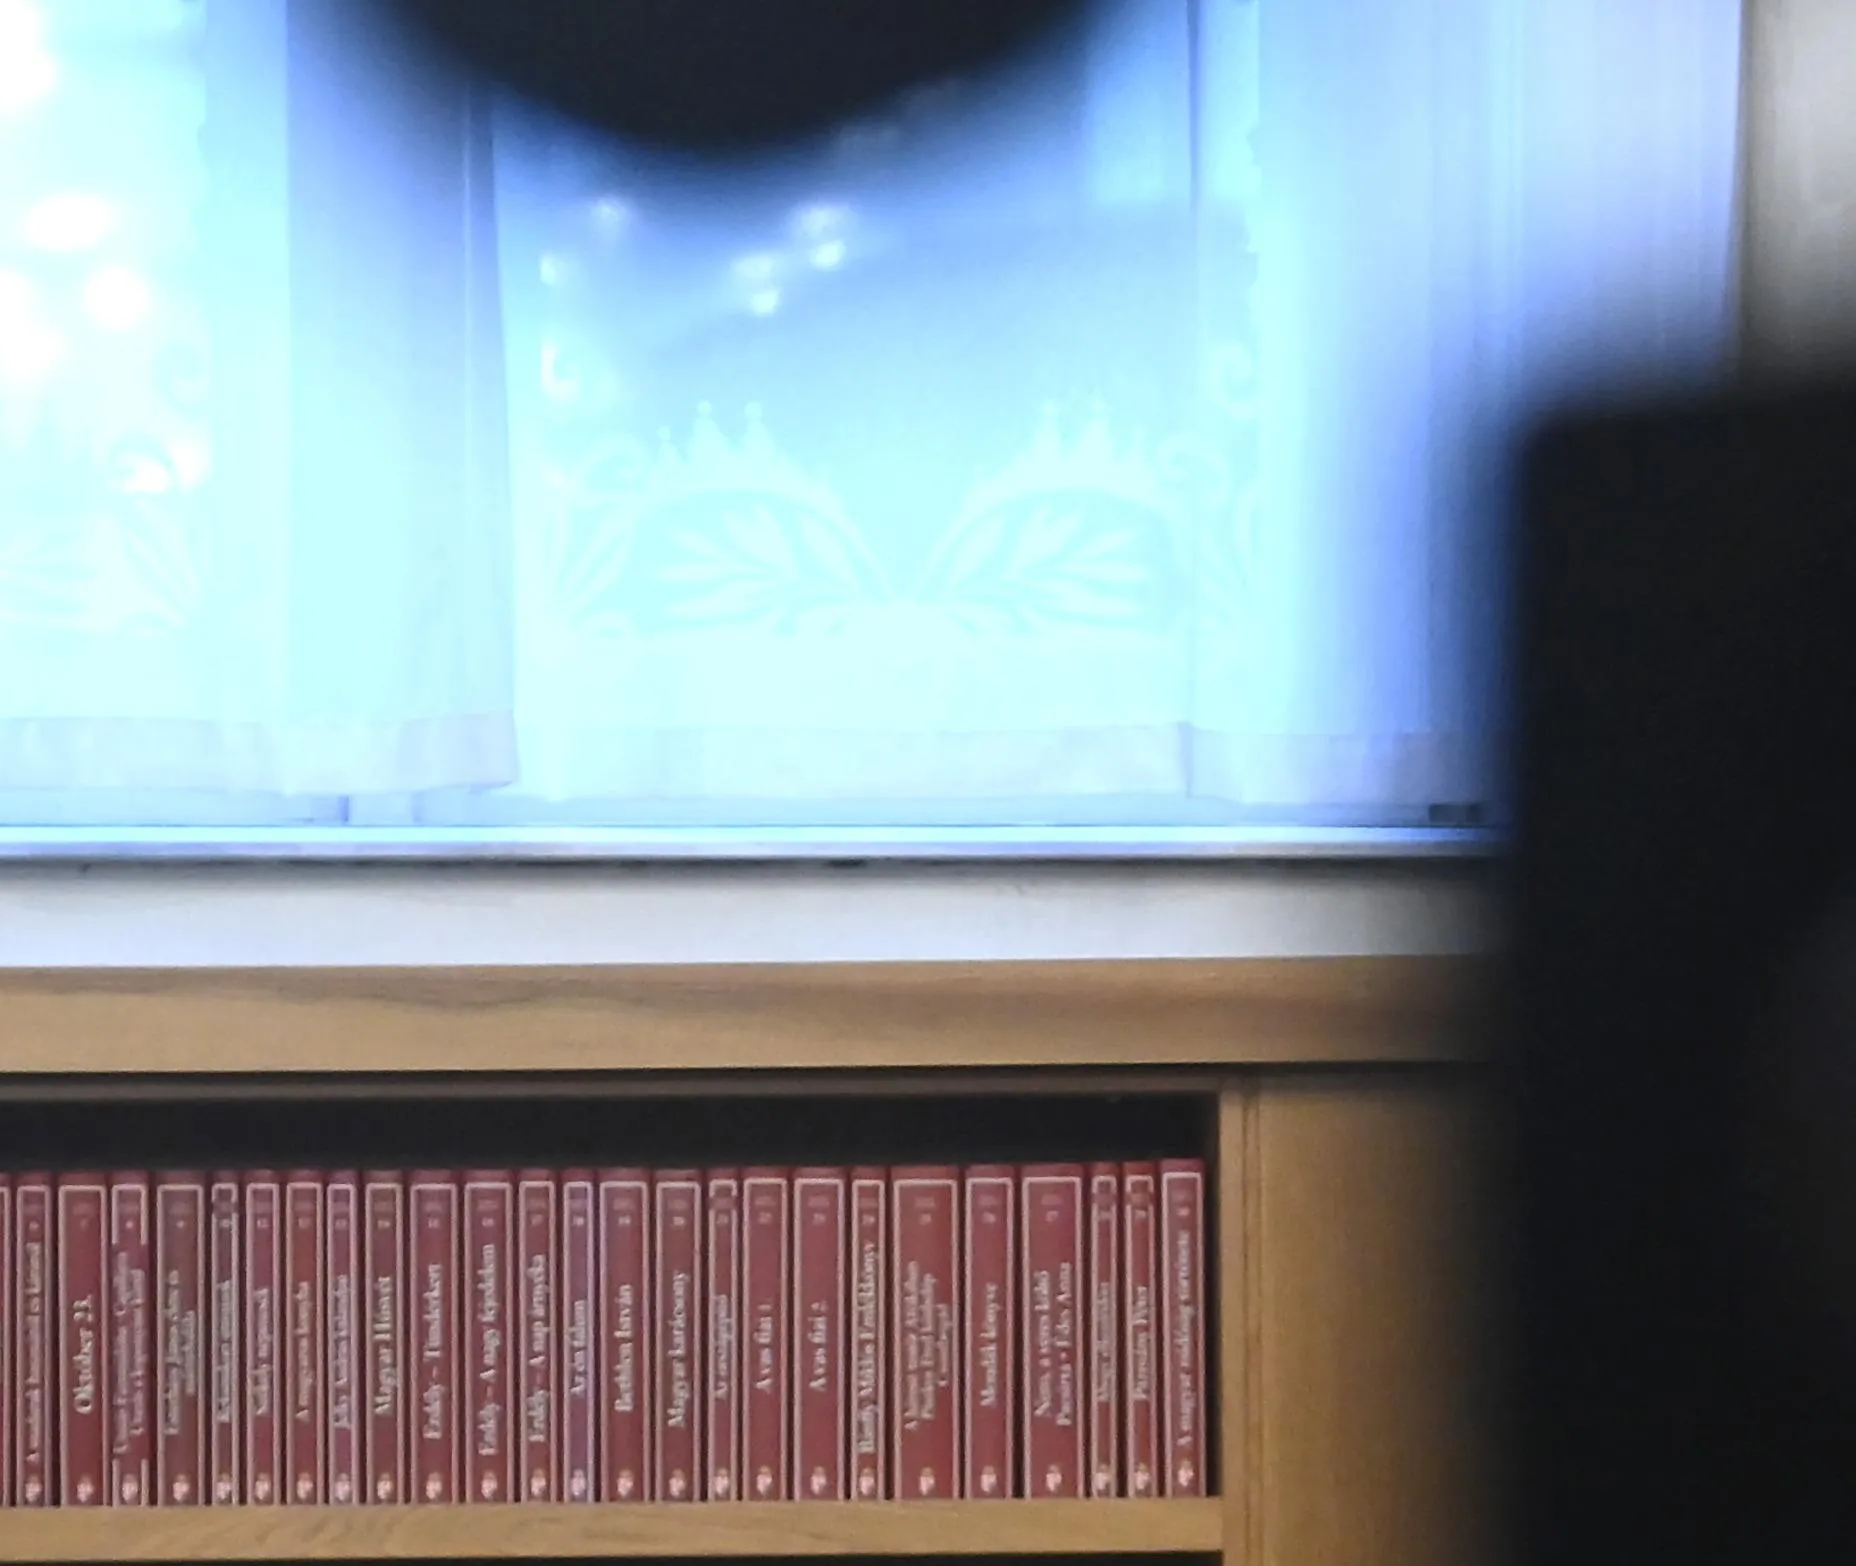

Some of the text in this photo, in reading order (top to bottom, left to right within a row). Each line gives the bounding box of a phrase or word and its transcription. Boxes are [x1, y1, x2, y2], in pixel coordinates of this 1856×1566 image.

[484, 1328, 503, 1365] nagy
[533, 1321, 552, 1352] nap
[613, 1284, 634, 1412] Bethlen István
[666, 1272, 690, 1428] Magyar karácsony
[72, 1328, 94, 1414] Október
[478, 1369, 496, 1382] A
[528, 1355, 547, 1368] A
[374, 1345, 397, 1416] Magyar
[754, 1378, 772, 1391] A
[809, 1378, 828, 1391] A
